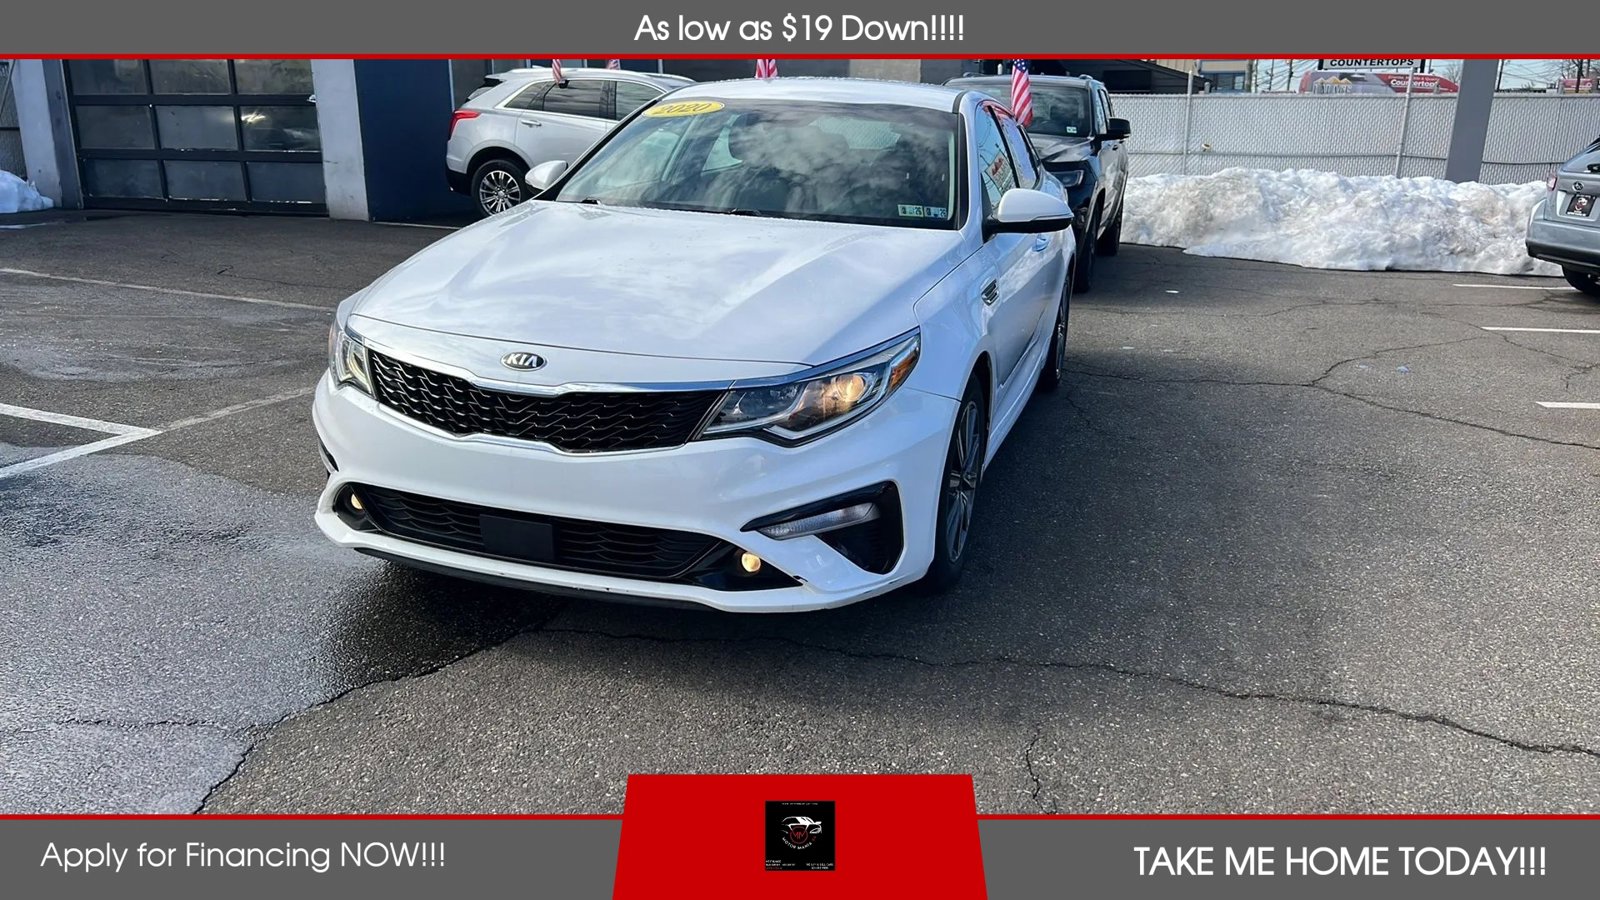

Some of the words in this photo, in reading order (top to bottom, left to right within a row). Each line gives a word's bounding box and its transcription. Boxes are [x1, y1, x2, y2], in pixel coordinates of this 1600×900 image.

[1330, 59, 1414, 67] COUNTERTOPS
[652, 103, 712, 115] 2020
[506, 353, 538, 368] KIA
